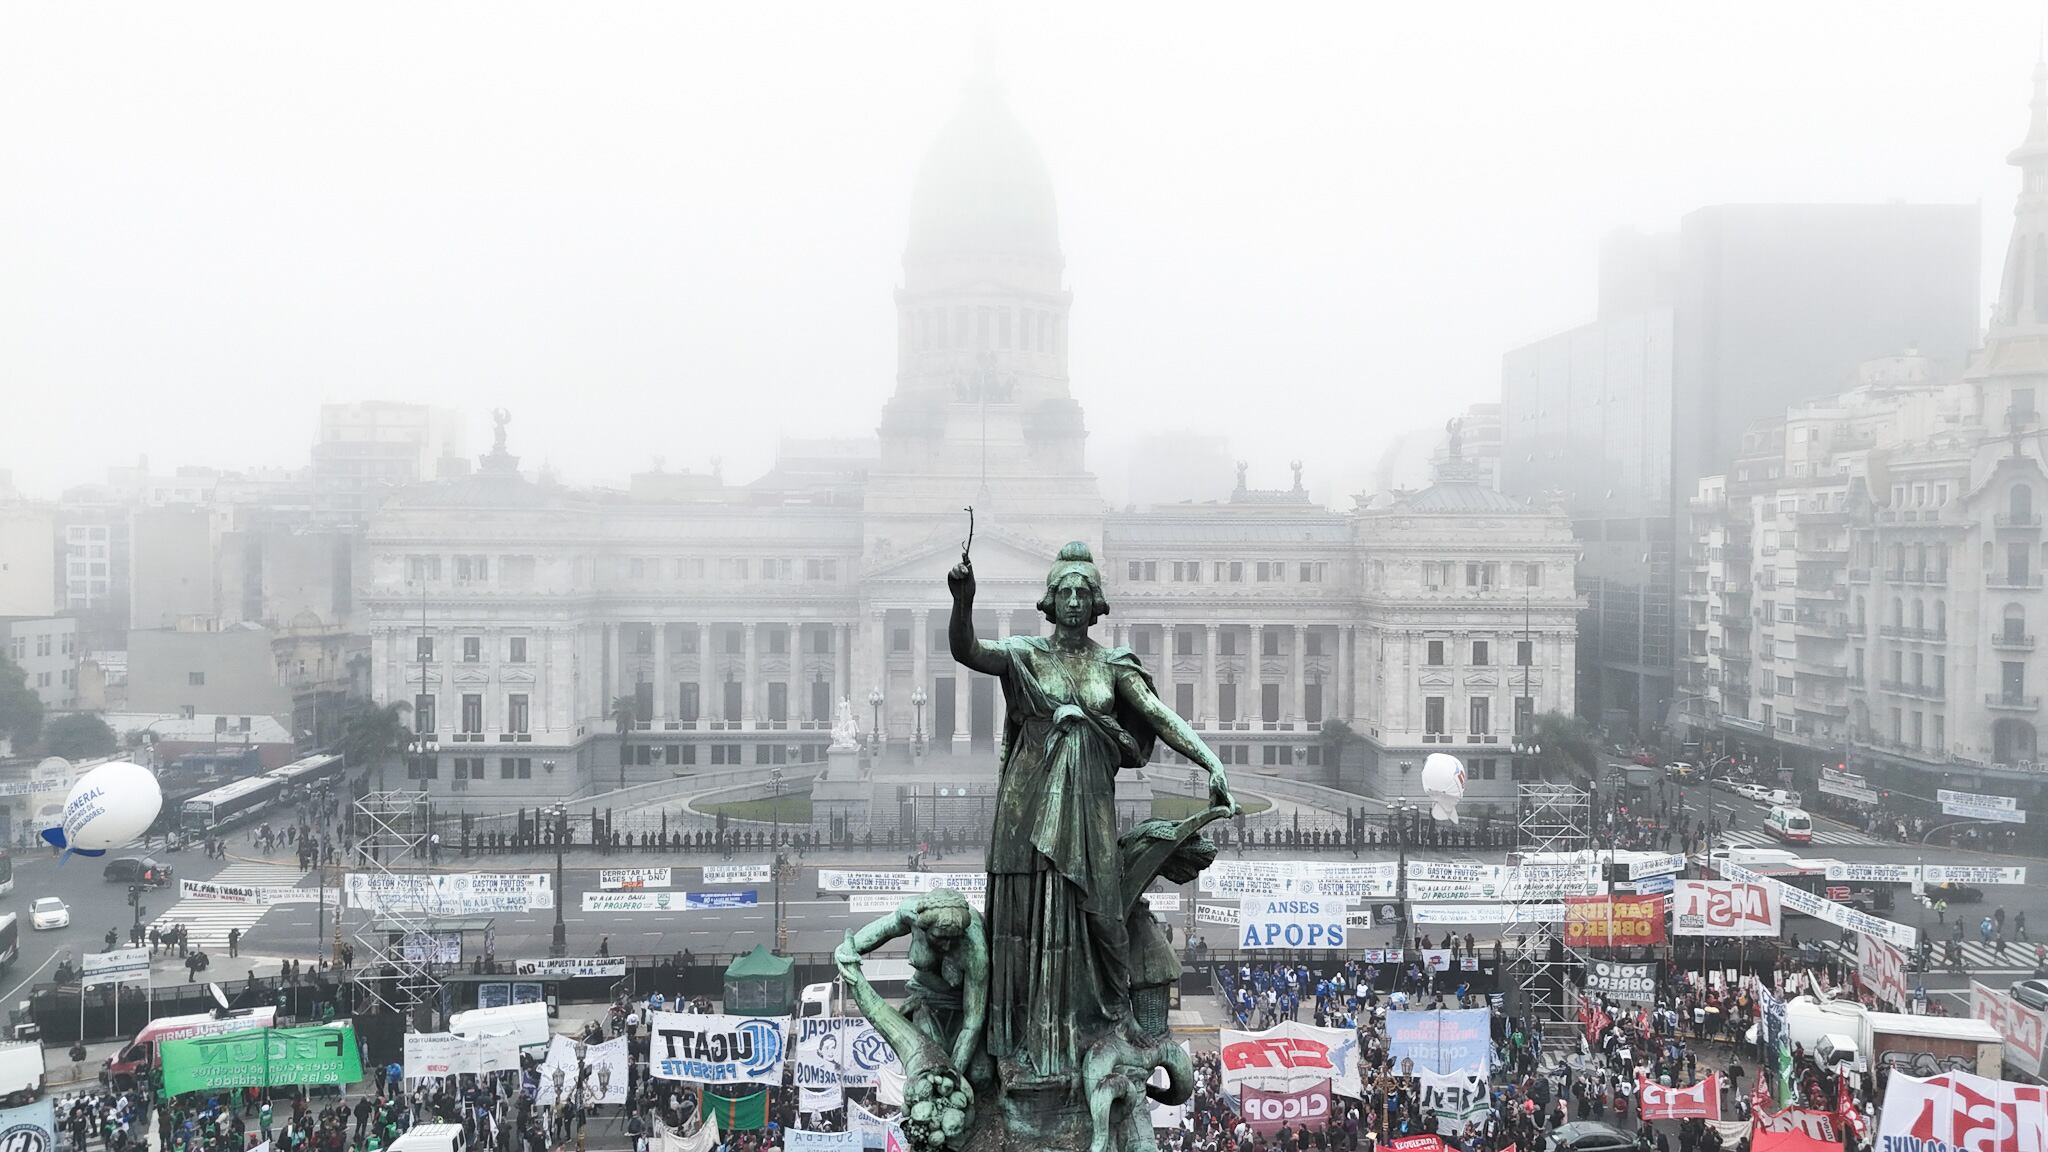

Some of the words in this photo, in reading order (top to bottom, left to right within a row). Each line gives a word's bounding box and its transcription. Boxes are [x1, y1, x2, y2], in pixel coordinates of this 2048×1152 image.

[67, 786, 104, 816] GENERAL
[1267, 901, 1320, 914] ANSES
[1346, 916, 1367, 925] ENDE
[1243, 924, 1344, 946] APOPS
[519, 963, 535, 975] NO
[155, 1028, 193, 1042] FIRME
